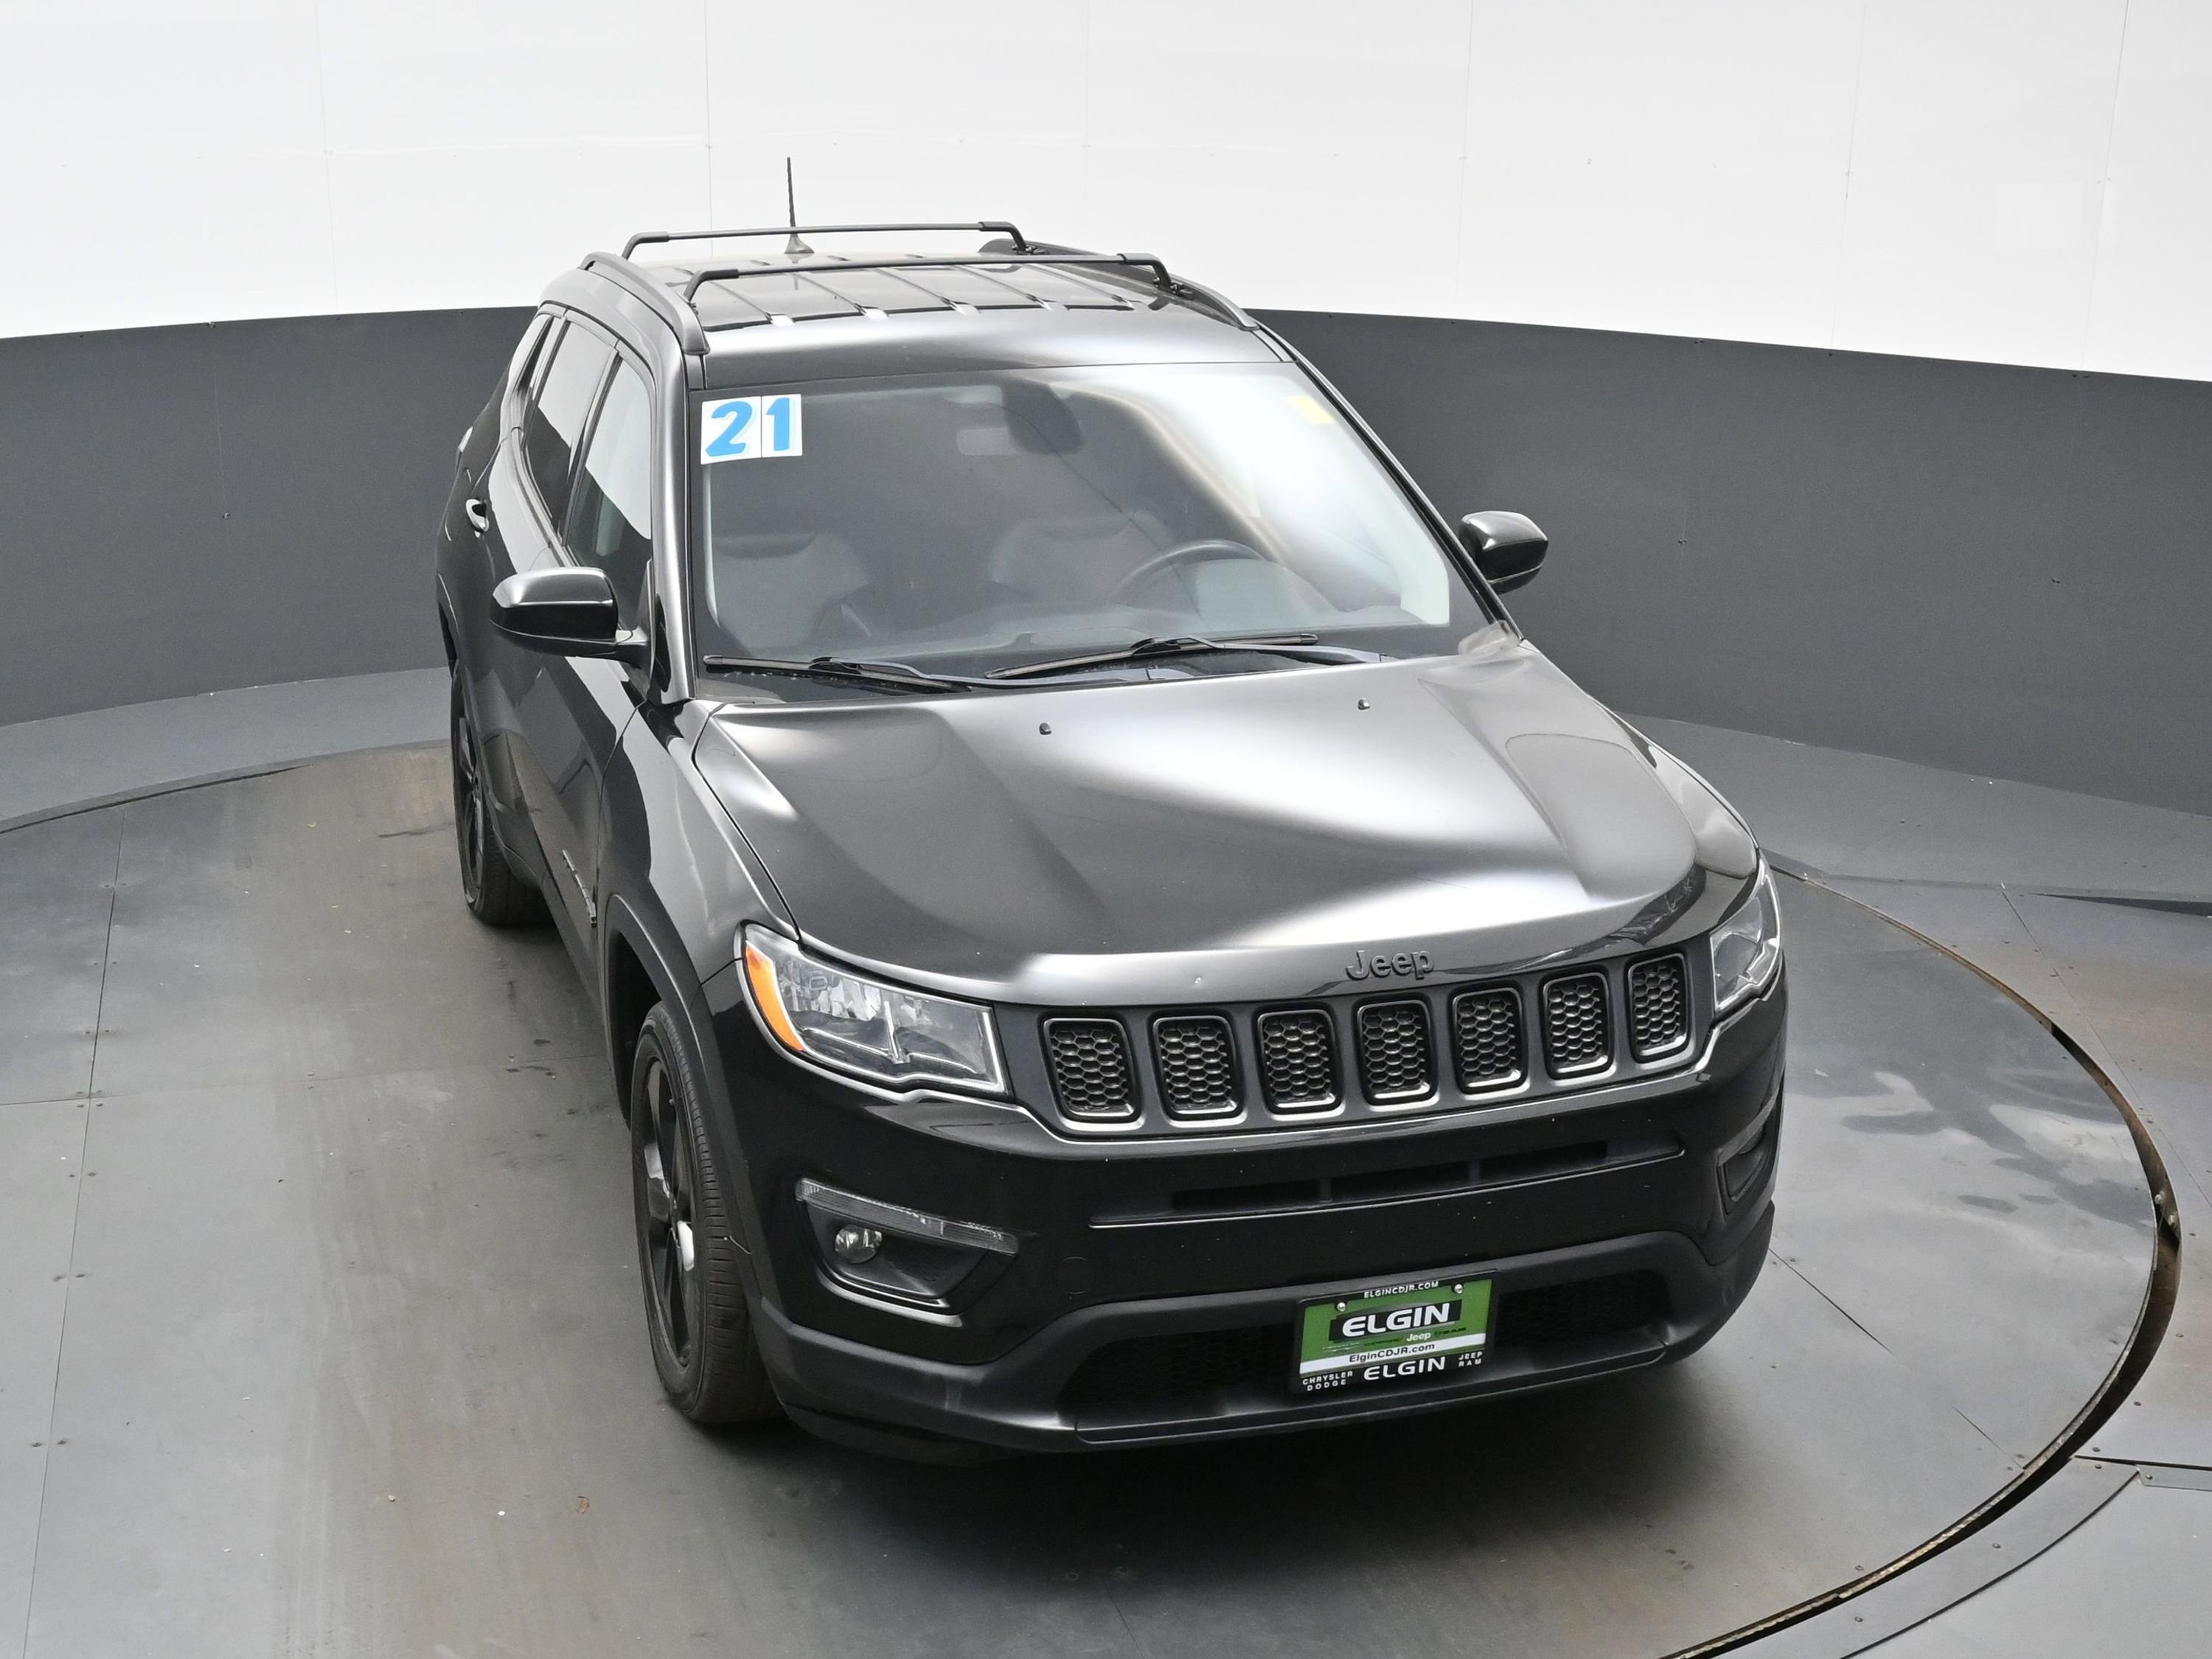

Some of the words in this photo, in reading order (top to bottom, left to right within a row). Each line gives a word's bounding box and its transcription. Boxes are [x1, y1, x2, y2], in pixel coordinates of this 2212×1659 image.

[706, 397, 790, 457] 21
[1345, 950, 1434, 981] Jeep
[1363, 1281, 1439, 1298] ELGINCDJR.COM
[1342, 1303, 1450, 1337] ELGIN
[1406, 1332, 1431, 1341] Jeep
[1349, 1343, 1435, 1363] ElginCDJR.com
[1458, 1351, 1483, 1360] JEEP
[1363, 1356, 1445, 1380] ELGIN
[1458, 1358, 1481, 1368] RAM
[1302, 1371, 1353, 1385] CHRYSLER
[1307, 1378, 1346, 1391] DODGE
